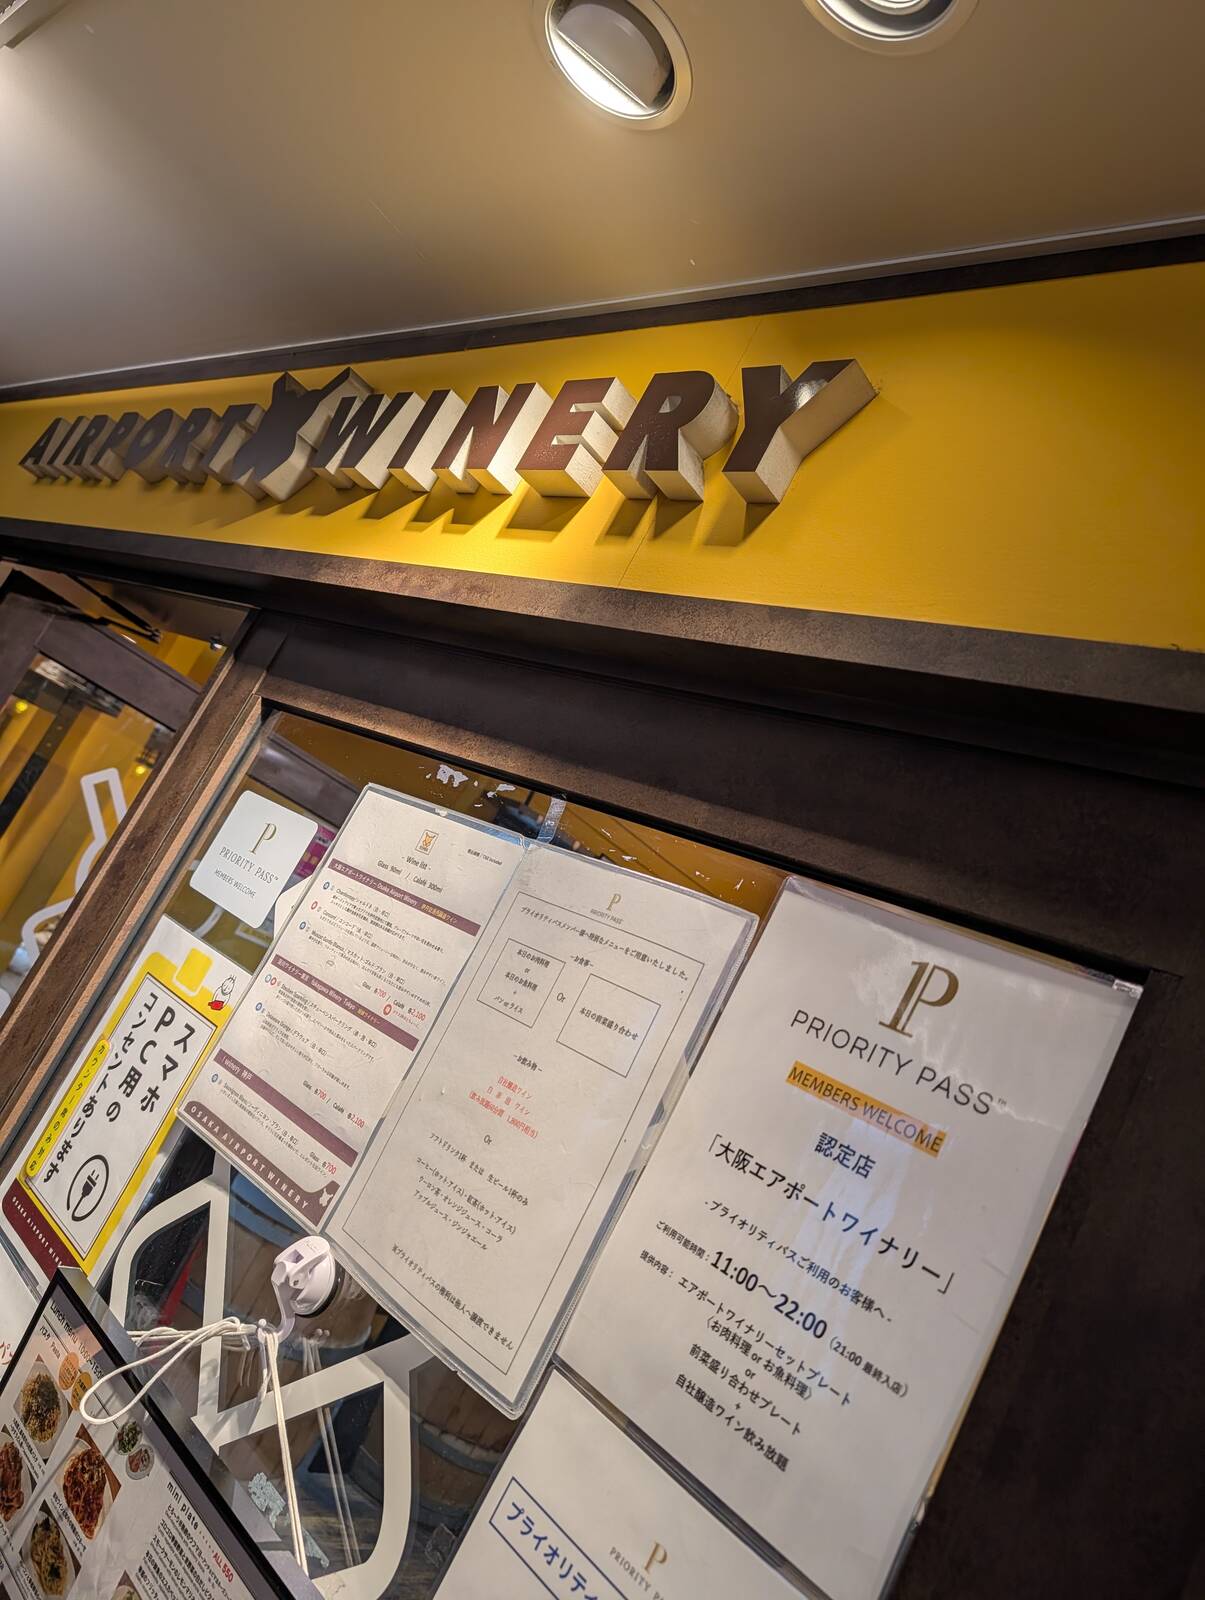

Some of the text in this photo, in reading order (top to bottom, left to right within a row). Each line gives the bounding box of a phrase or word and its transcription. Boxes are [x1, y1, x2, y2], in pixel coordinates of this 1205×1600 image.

[20, 359, 879, 503] AIRPORT WINERY
[213, 868, 257, 898] MEMBERS WELCOME
[219, 846, 254, 875] PRIORITY
[377, 861, 389, 869] Glass
[427, 882, 442, 892] 300ml
[405, 856, 419, 866] Wine
[376, 883, 389, 892] Osaka
[388, 888, 403, 899] Airport
[402, 895, 417, 906] Winery
[516, 948, 550, 968] 本日のお肉料理
[555, 992, 566, 1003] Or
[579, 1007, 639, 1041] 本日の前菜盛り合わせ
[790, 1009, 913, 1076] PRIORITY
[43, 991, 158, 1184] コンセントあります
[105, 1005, 175, 1123] PC用の
[139, 1022, 196, 1113] スマホ
[241, 1069, 251, 1081] 神戸
[787, 1066, 944, 1153] MEMBERS WELCOME
[190, 1105, 219, 1133] OSAKA
[222, 1132, 265, 1172] AIRPORT
[267, 1171, 308, 1210] WINERY
[483, 1134, 492, 1145] Or
[814, 1132, 876, 1179] 認定店
[469, 1160, 484, 1175] または
[487, 1172, 529, 1207] 生ビール1杯のみ
[12, 1196, 27, 1218] OSAKA
[26, 1217, 49, 1248] AIRPORT
[413, 1189, 487, 1252] アップルジュース・ジンジャエール
[418, 1175, 502, 1245] ウーロン茶・オレンジジュース・コーラ
[706, 1133, 957, 1295] 「大阪エアポートワイナリー」
[39, 1326, 62, 1360] パスタ Pasta
[50, 1302, 66, 1329] Lunch
[63, 1319, 78, 1345] menu
[678, 1276, 852, 1407] エアポートワイナリーセットプレート
[744, 1368, 757, 1380] or
[751, 1353, 762, 1364] or
[689, 1343, 801, 1435] 前菜盛り合わせプレート
[675, 1373, 789, 1473] 自社醸造ワイン飲み放題
[167, 1482, 234, 1583] mini plate ALL 550
[610, 1546, 652, 1592] PRIORITY
